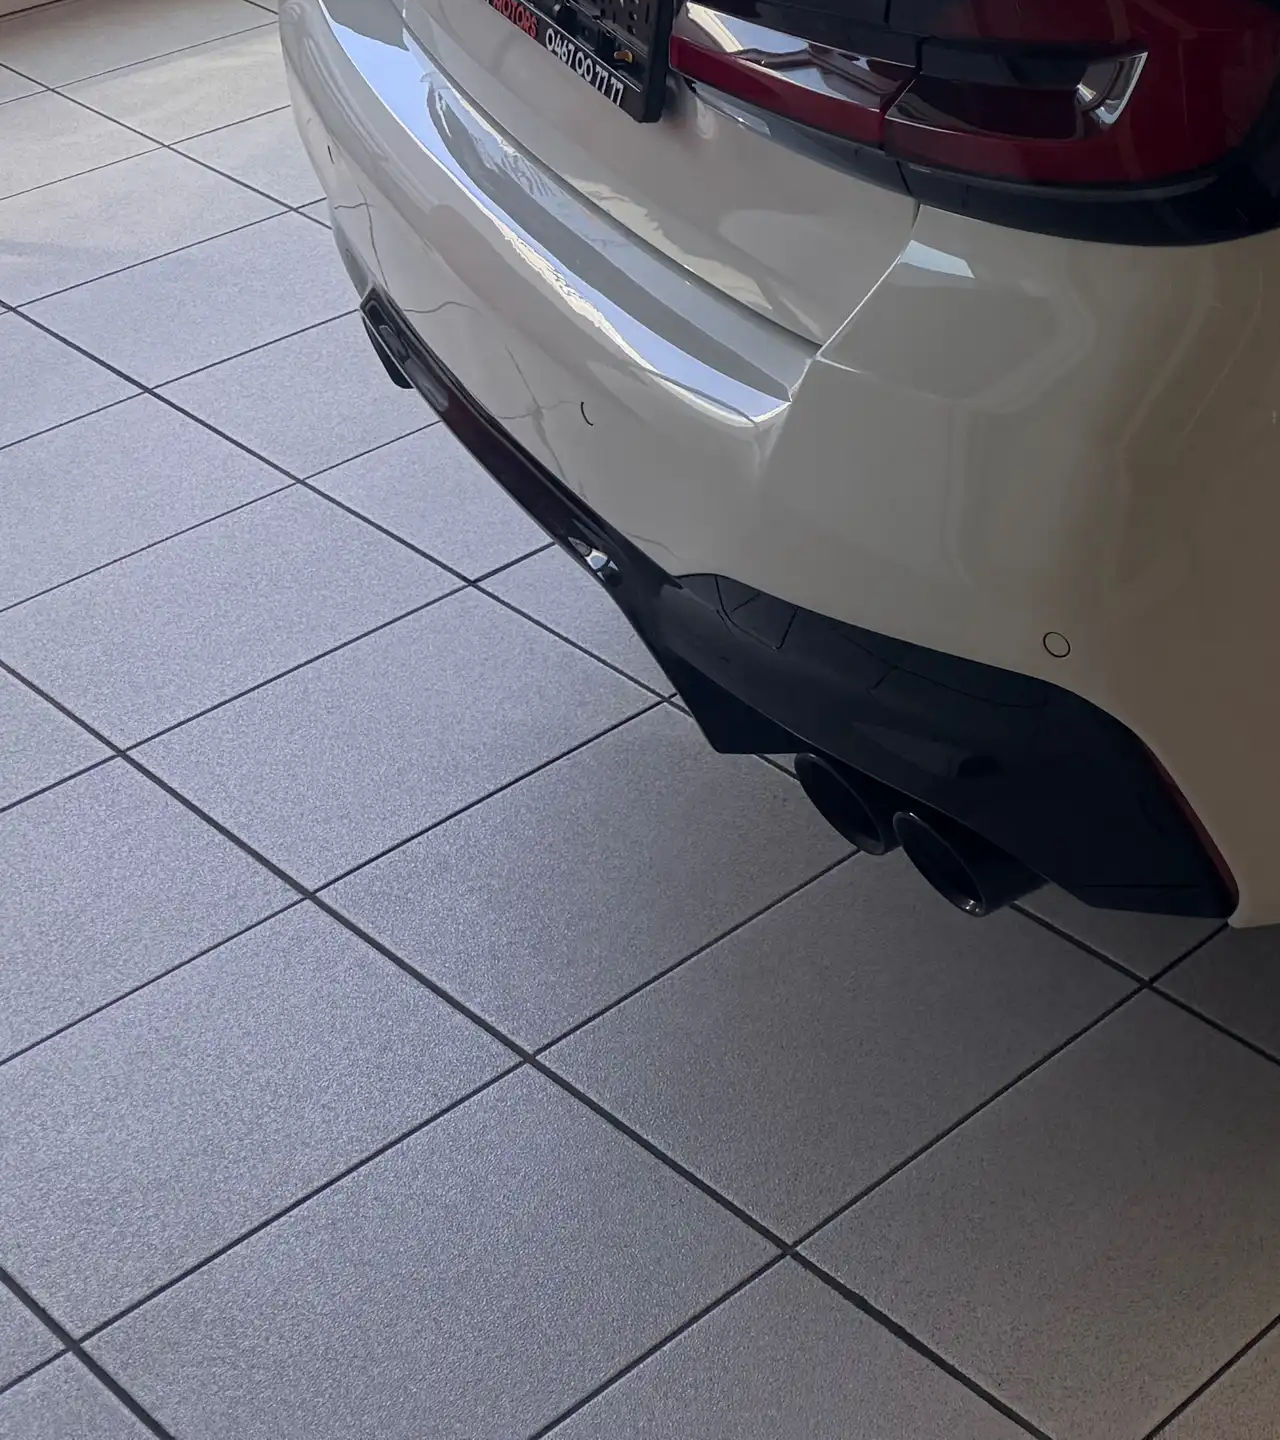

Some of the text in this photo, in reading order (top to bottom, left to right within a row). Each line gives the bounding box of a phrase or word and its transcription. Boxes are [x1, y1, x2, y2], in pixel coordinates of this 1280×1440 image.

[545, 27, 575, 67] 0467
[575, 52, 594, 83] 00
[595, 64, 609, 95] 77
[609, 79, 625, 107] 77
